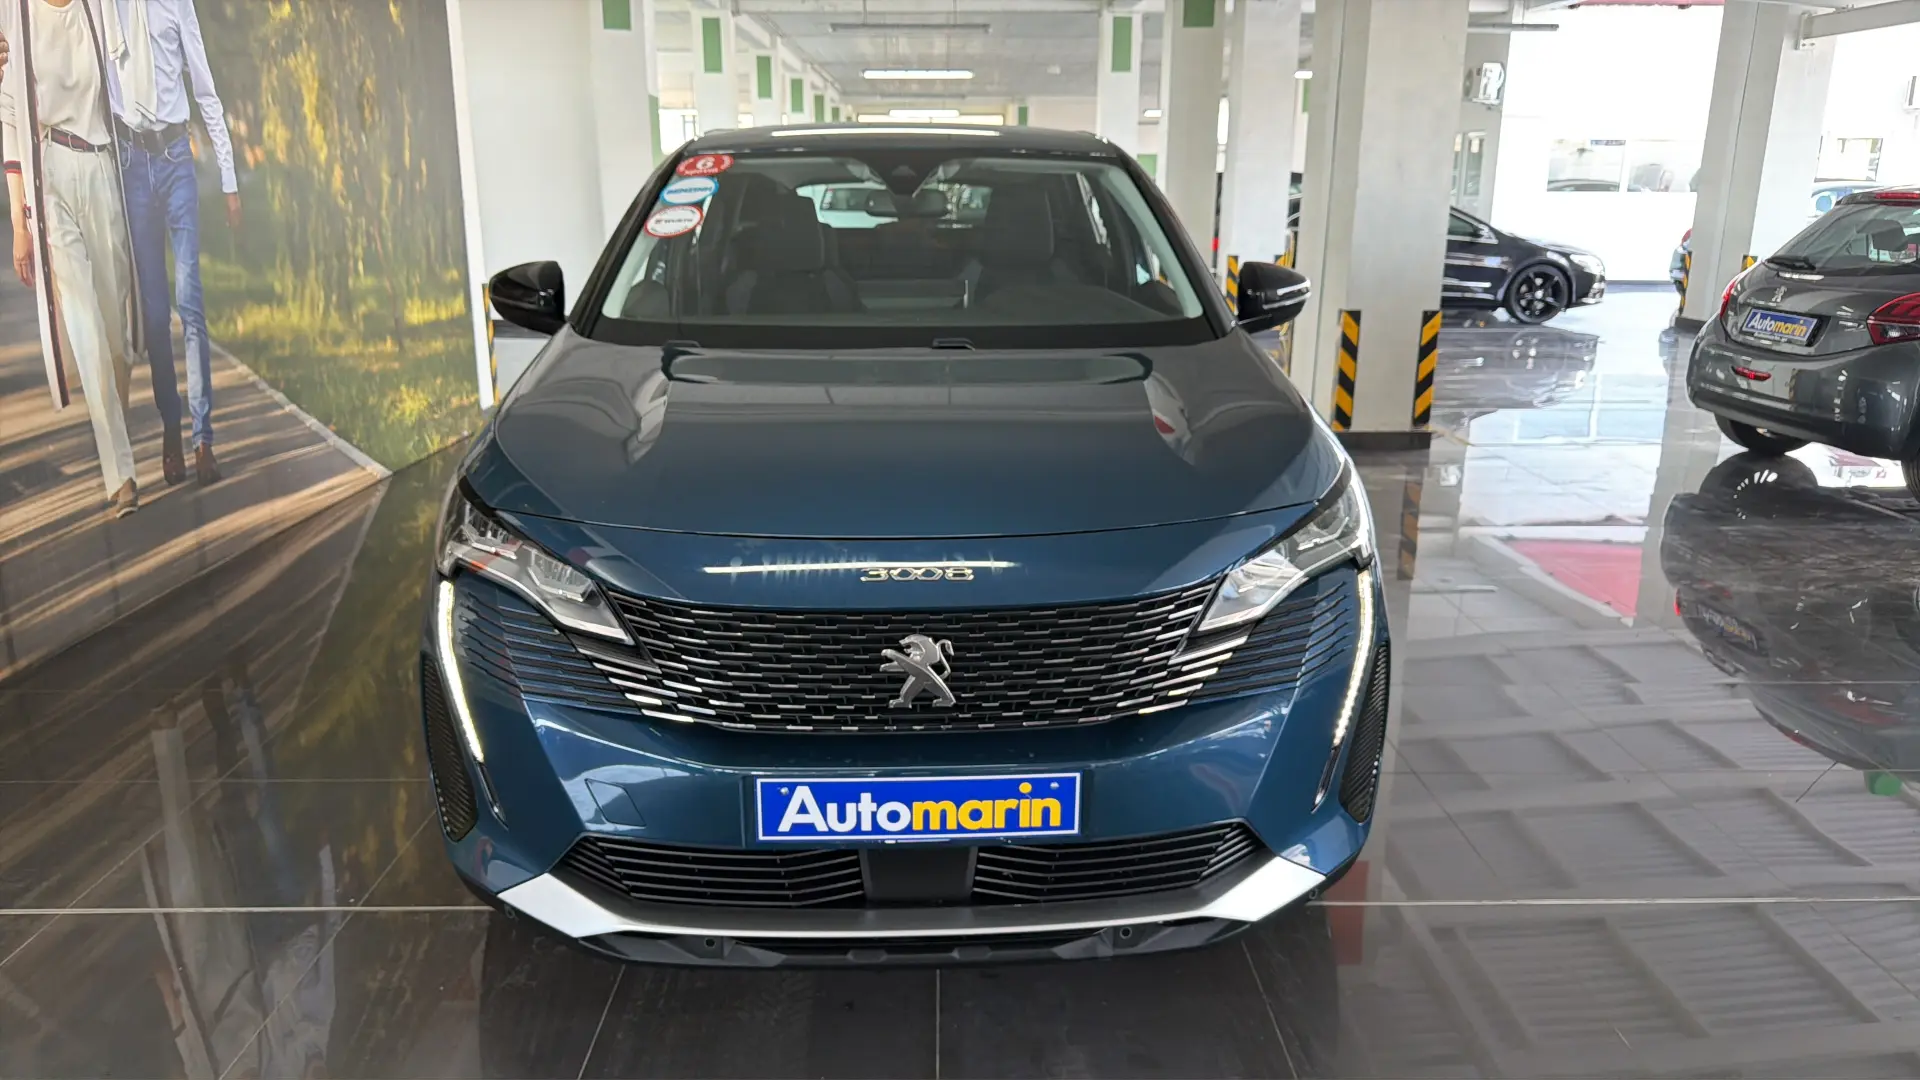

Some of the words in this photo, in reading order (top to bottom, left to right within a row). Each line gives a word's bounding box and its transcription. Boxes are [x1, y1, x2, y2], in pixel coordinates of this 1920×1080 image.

[1749, 312, 1807, 336] Automarin
[860, 567, 975, 581] 3008
[778, 782, 1061, 832] Automarin
